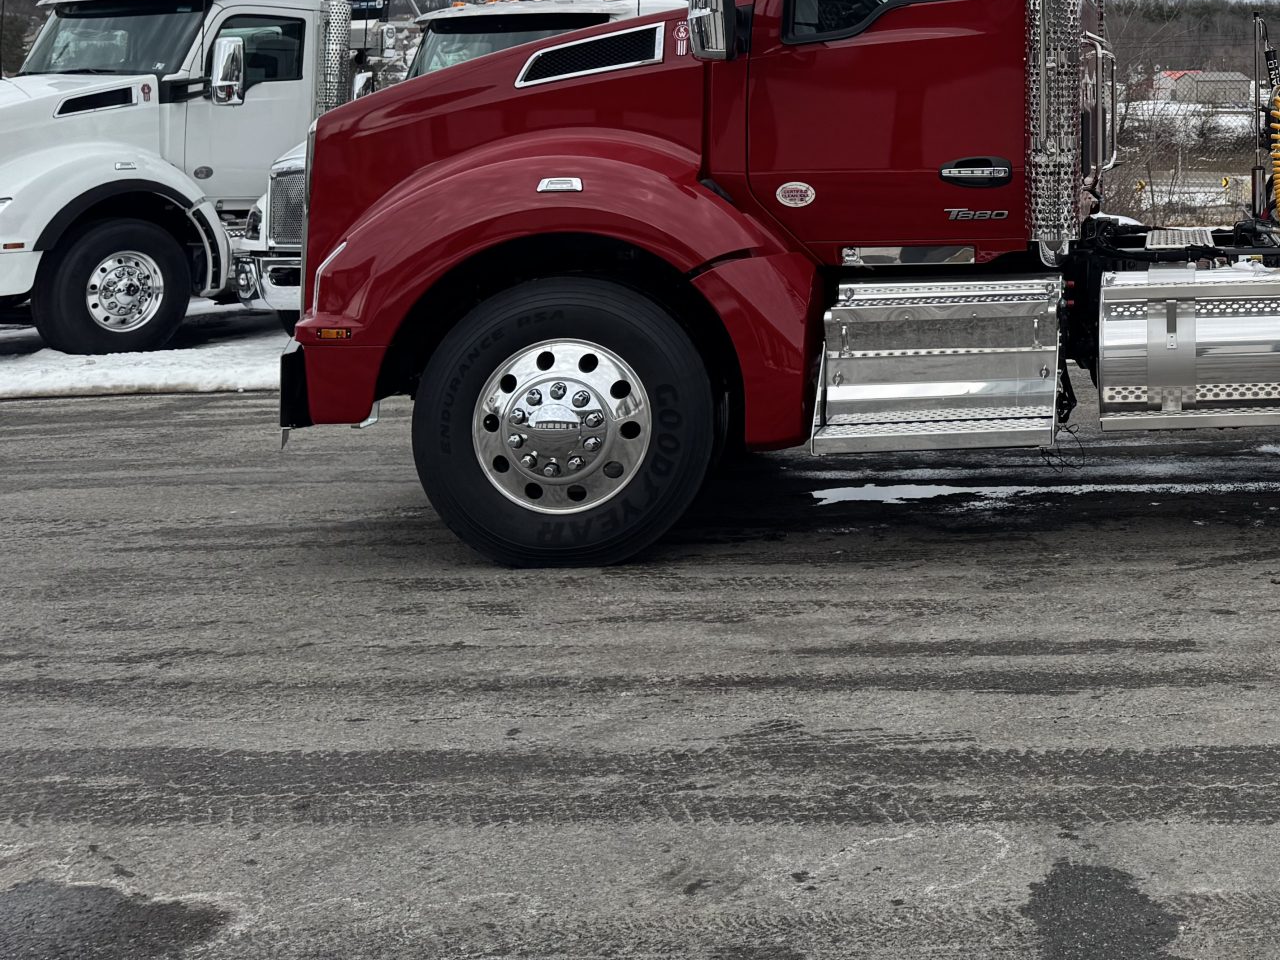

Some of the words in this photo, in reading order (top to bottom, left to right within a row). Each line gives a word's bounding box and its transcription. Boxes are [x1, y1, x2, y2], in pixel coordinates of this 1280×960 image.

[943, 208, 1009, 220] T880
[439, 328, 507, 456] ENDURANCE
[517, 308, 565, 329] RSA
